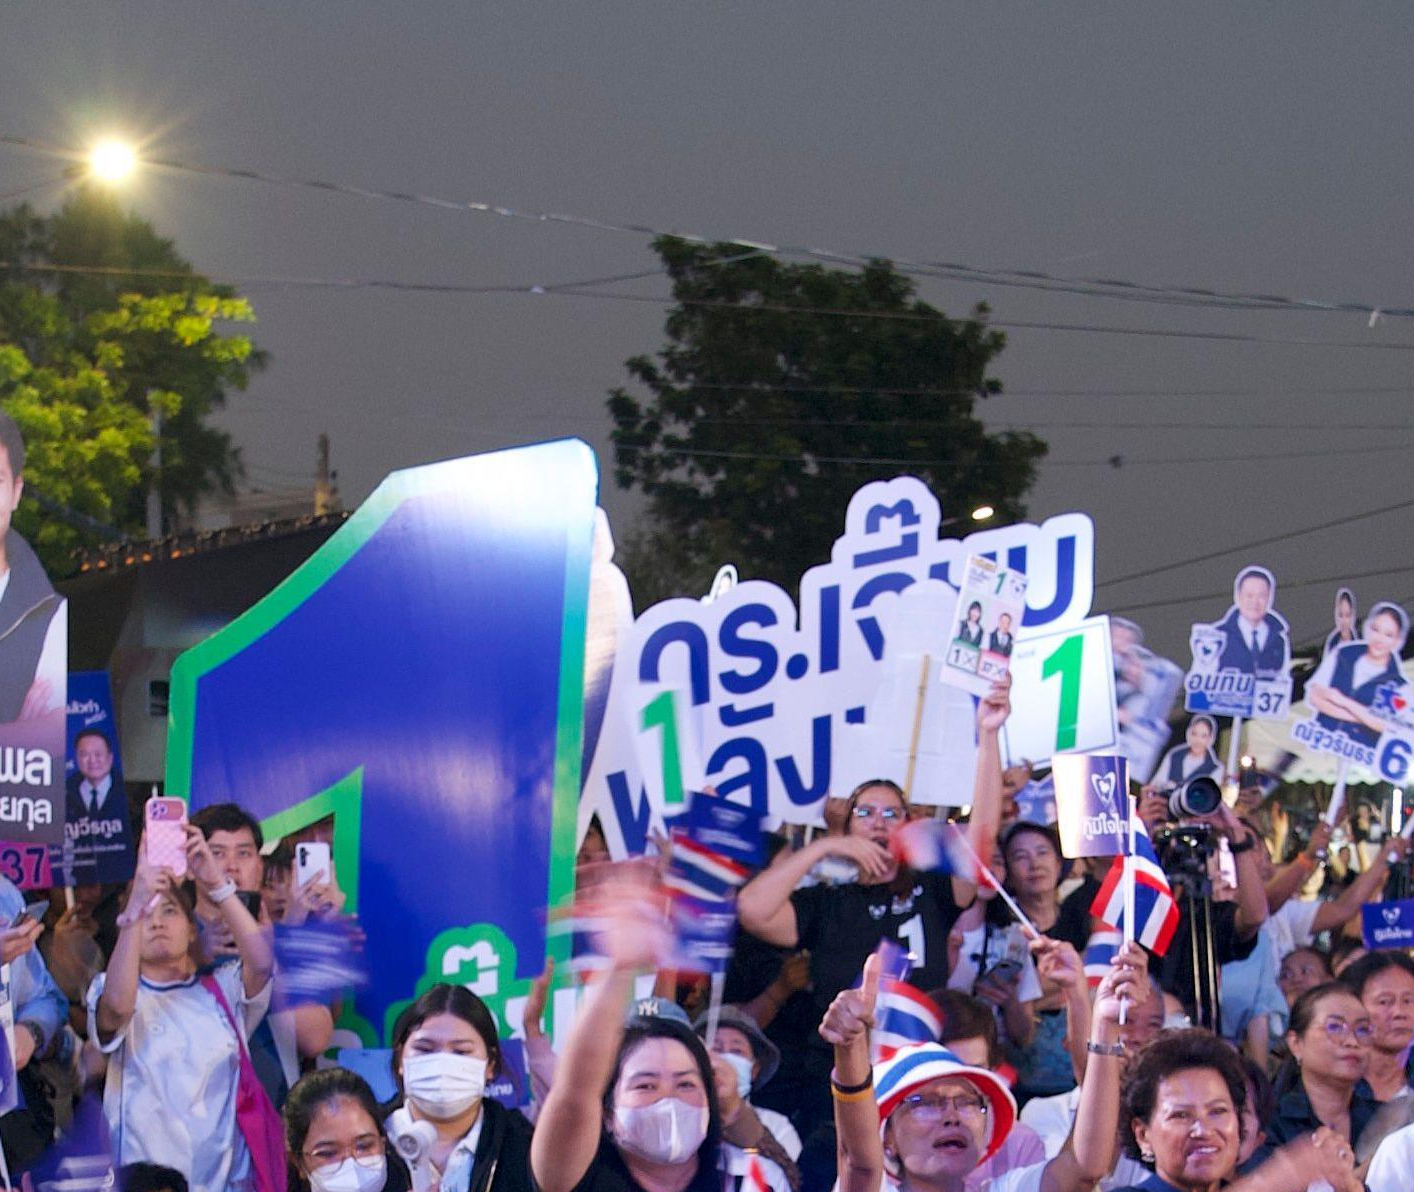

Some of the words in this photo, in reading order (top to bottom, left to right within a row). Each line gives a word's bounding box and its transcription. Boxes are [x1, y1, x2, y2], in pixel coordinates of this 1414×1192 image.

[1041, 633, 1084, 752] 1
[1258, 693, 1285, 714] 37
[639, 690, 684, 804] 1
[1380, 739, 1412, 780] 6
[2, 847, 47, 886] 37
[897, 911, 926, 968] 1
